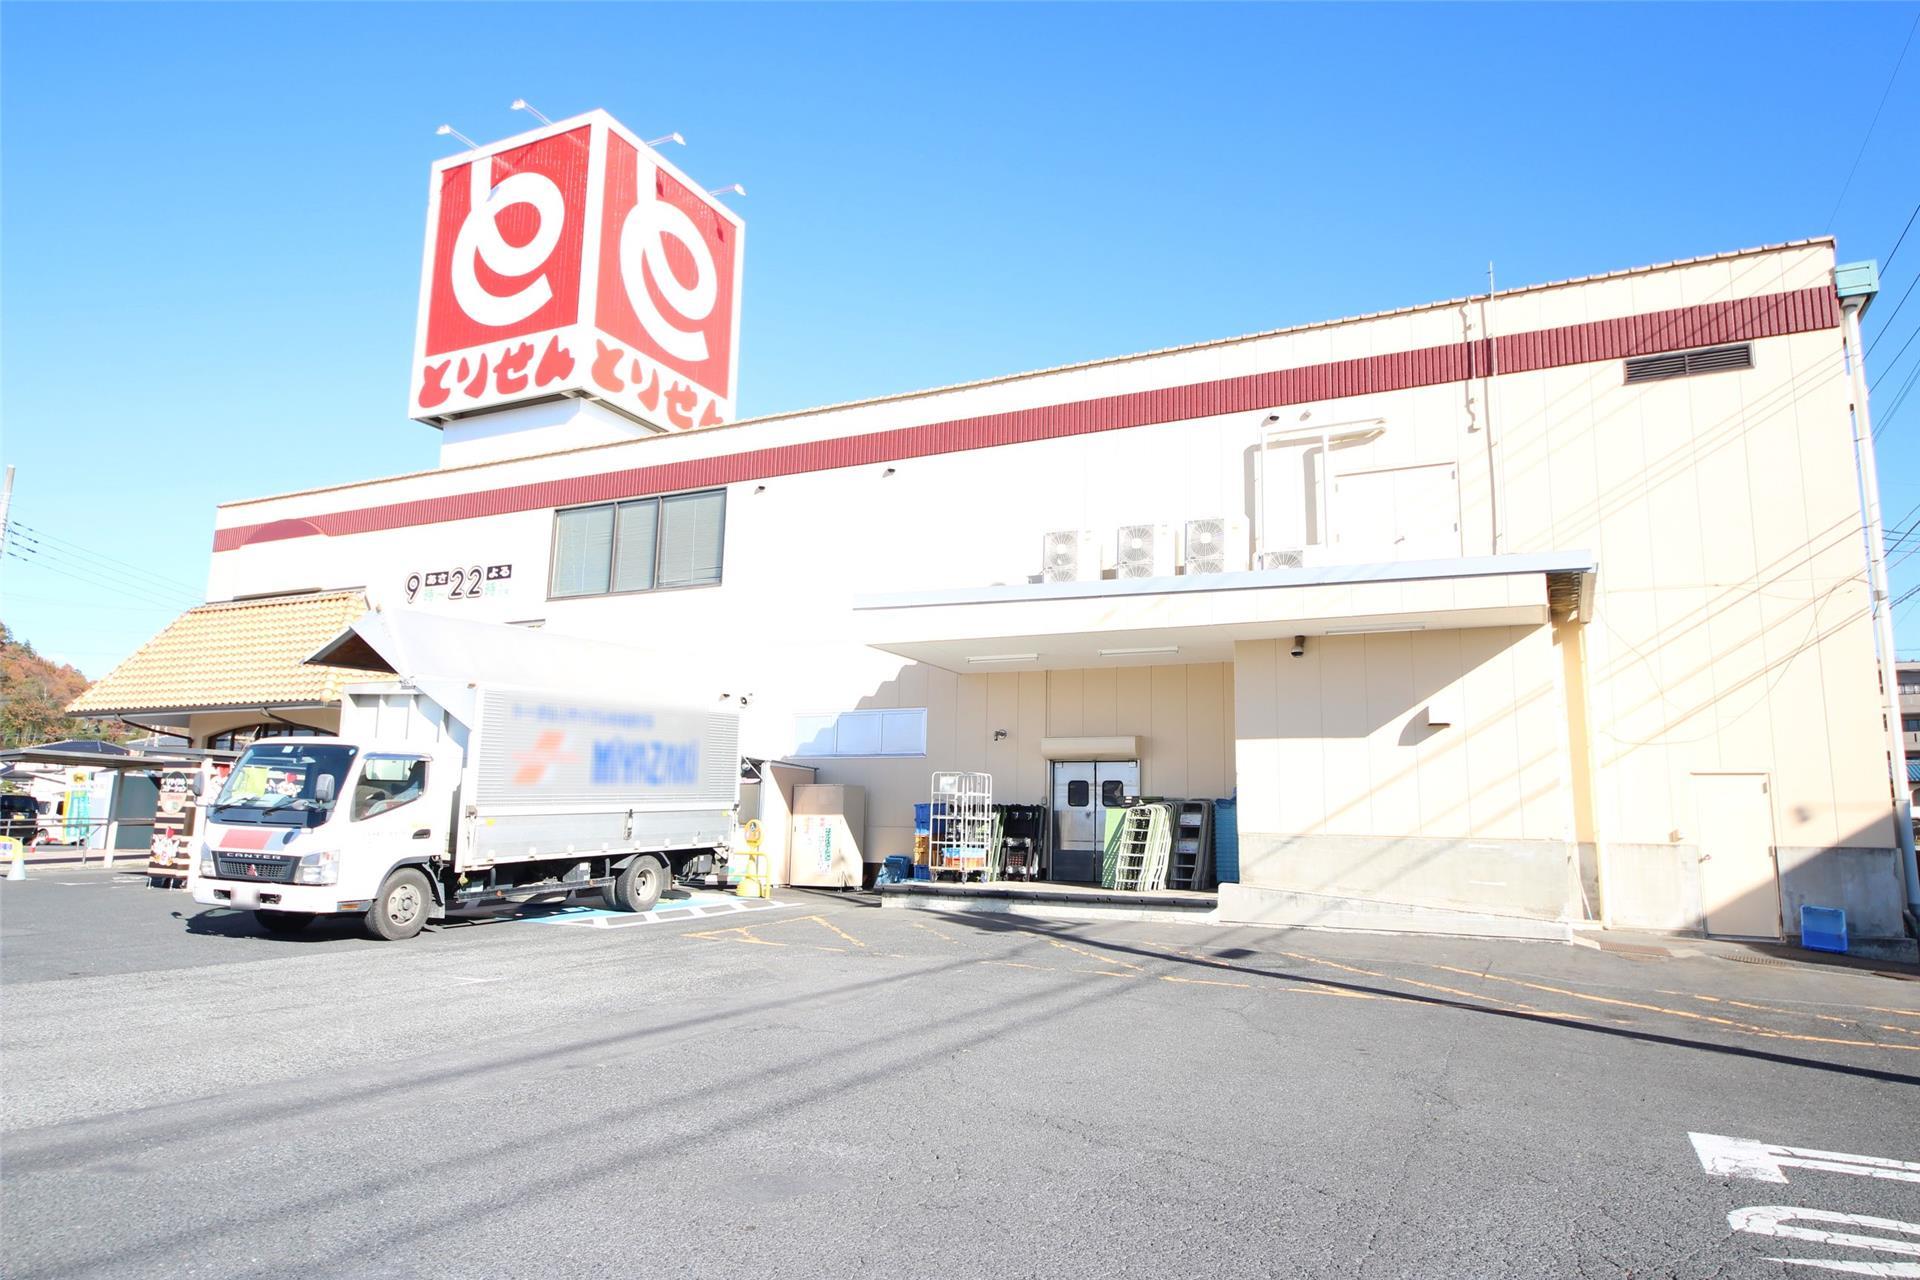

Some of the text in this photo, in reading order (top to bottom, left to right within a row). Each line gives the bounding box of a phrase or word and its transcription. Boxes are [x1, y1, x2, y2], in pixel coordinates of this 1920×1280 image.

[418, 335, 576, 409] とりせん
[226, 852, 281, 860] CANTER
